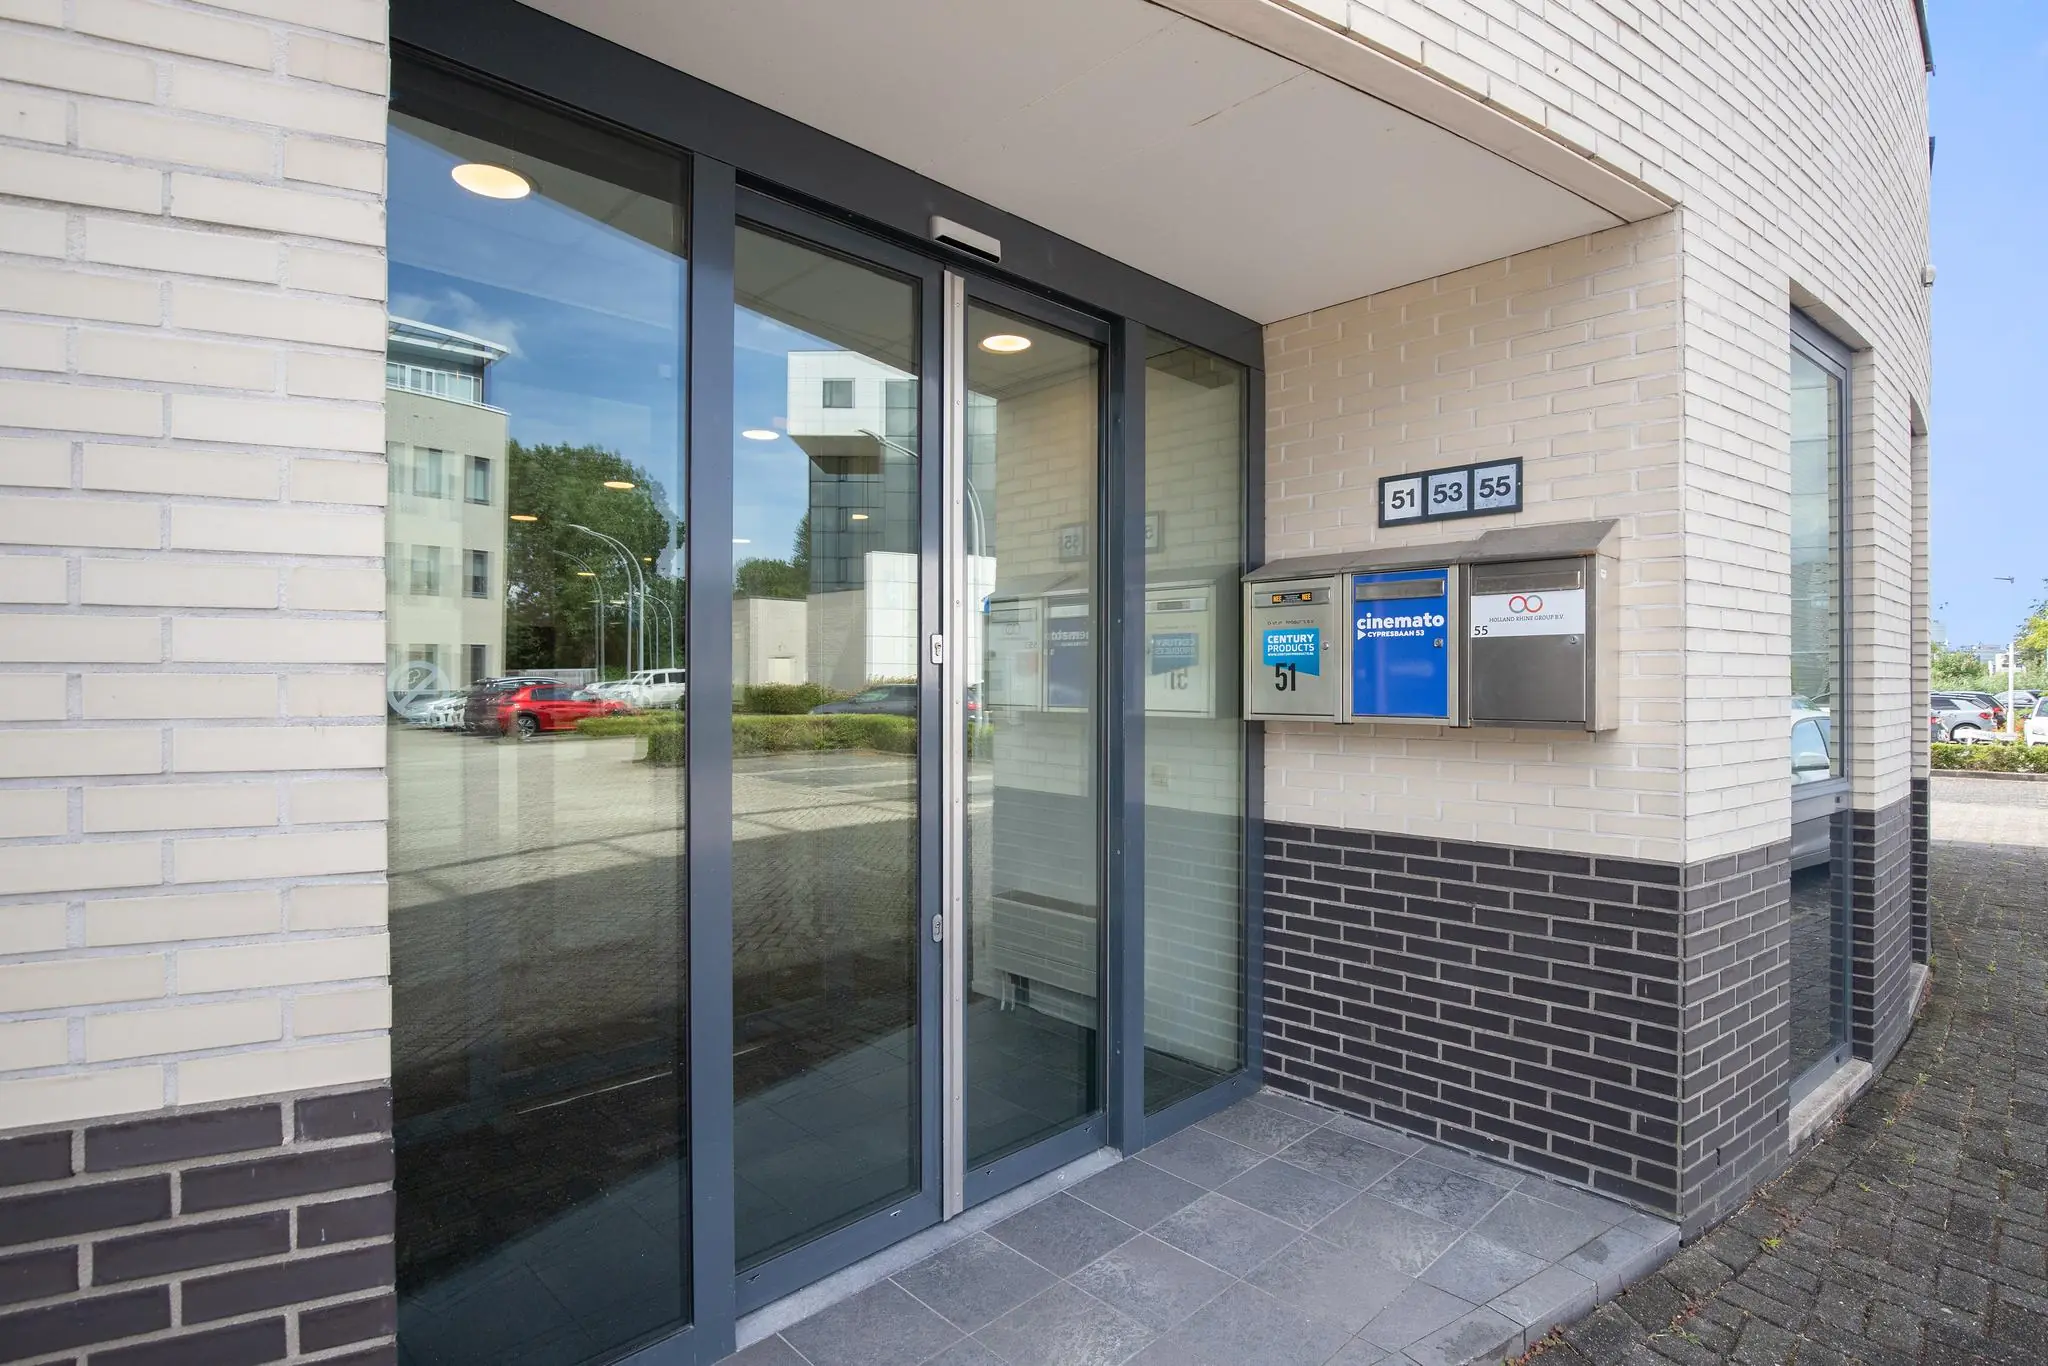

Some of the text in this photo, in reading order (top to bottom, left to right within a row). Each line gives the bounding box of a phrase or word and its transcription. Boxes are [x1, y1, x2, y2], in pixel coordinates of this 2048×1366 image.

[1391, 475, 1511, 510] 51 53 55
[1357, 612, 1445, 630] cinemato
[1367, 630, 1415, 638] CYPRESBAAN
[1474, 625, 1488, 636] 55
[1267, 634, 1314, 643] CENTURY
[1267, 644, 1314, 652] PRODUCTS
[1275, 662, 1296, 691] 51
